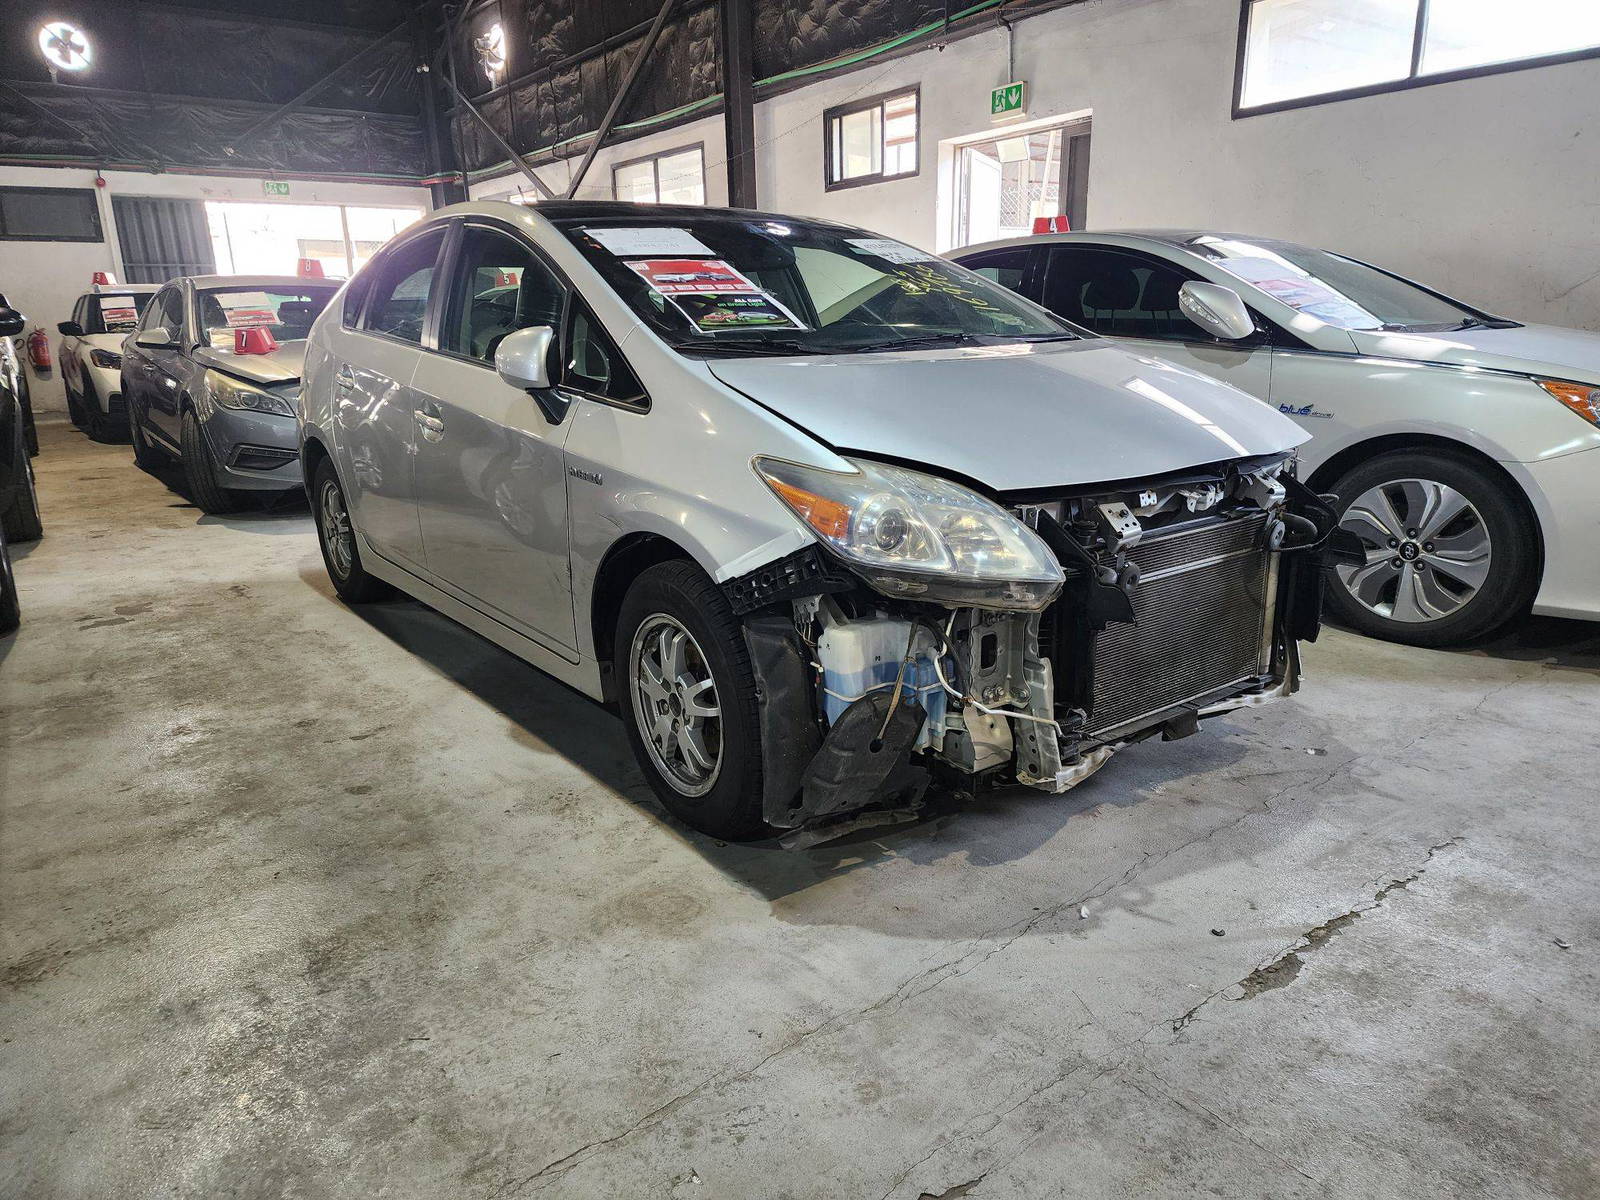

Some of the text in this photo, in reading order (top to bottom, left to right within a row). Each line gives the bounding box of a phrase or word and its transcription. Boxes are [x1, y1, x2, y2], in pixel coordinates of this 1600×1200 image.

[1050, 217, 1058, 234] 4
[503, 274, 510, 285] 5
[1279, 403, 1312, 416] blue
